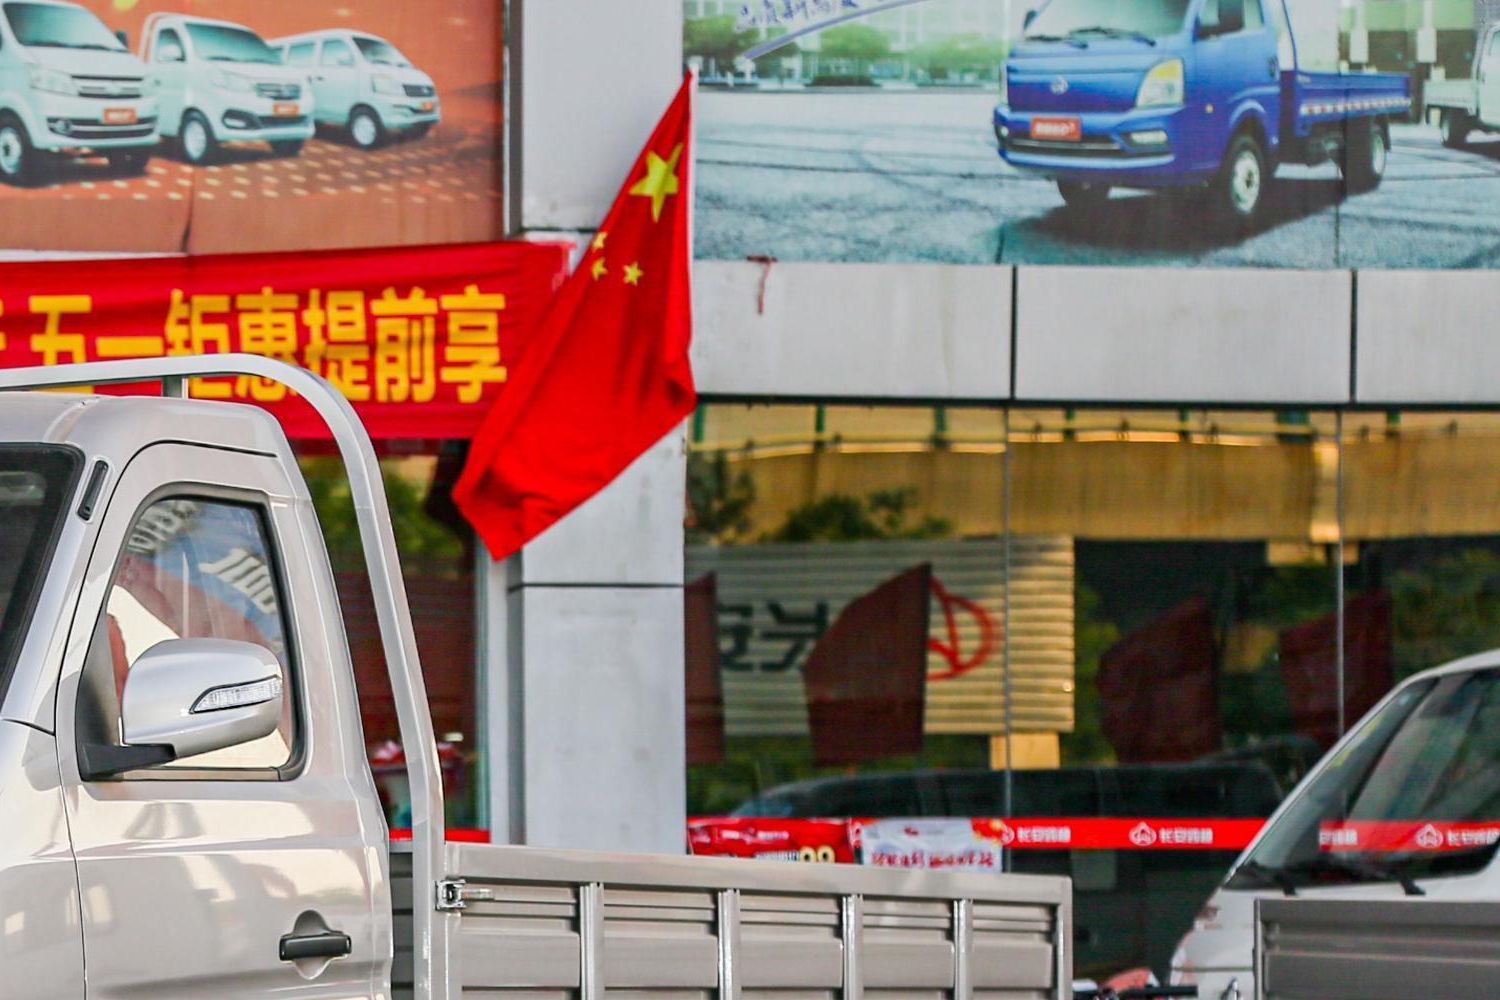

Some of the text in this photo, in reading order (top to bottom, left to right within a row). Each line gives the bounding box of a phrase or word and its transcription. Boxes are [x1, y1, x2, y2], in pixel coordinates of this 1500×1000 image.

[29, 285, 507, 402] 五一钜惠提前享
